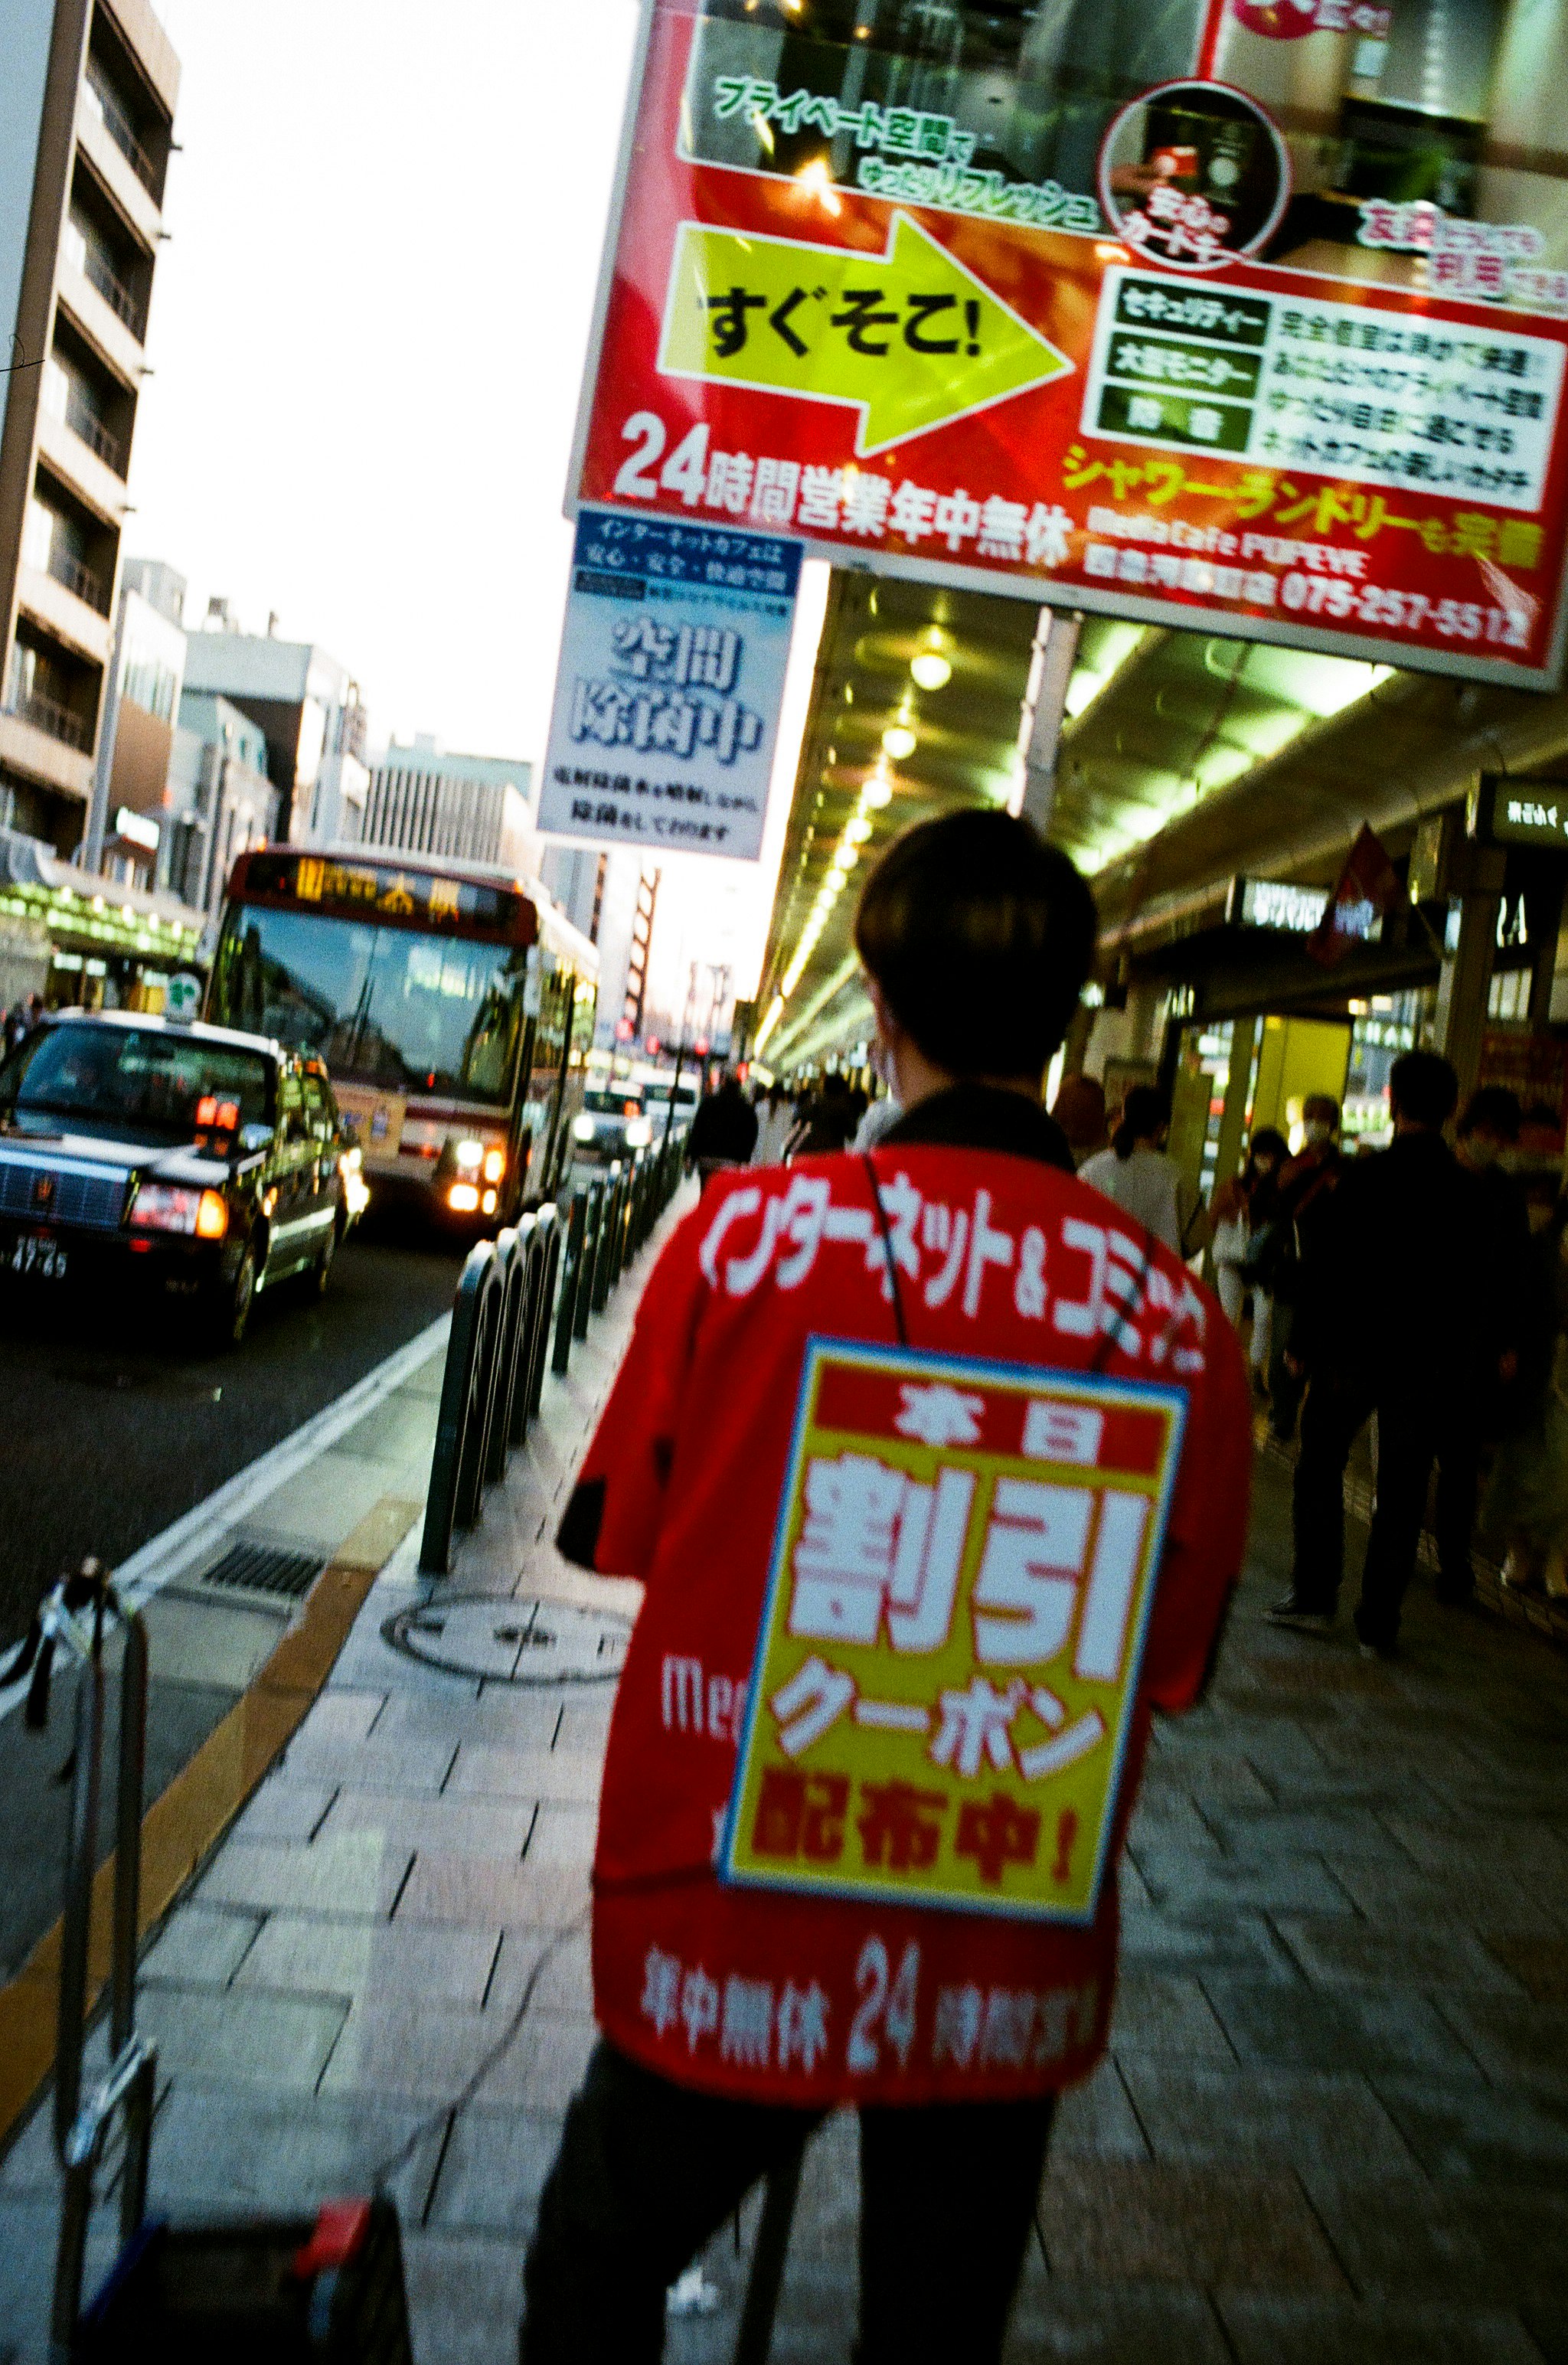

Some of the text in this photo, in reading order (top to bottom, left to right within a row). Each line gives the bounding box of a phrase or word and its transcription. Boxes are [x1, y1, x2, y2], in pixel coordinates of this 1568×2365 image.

[715, 76, 977, 165] プライベート空間で
[1122, 287, 1263, 335] セキュリティー
[893, 1383, 1102, 1466] 本日
[786, 1452, 1152, 1684] 割引
